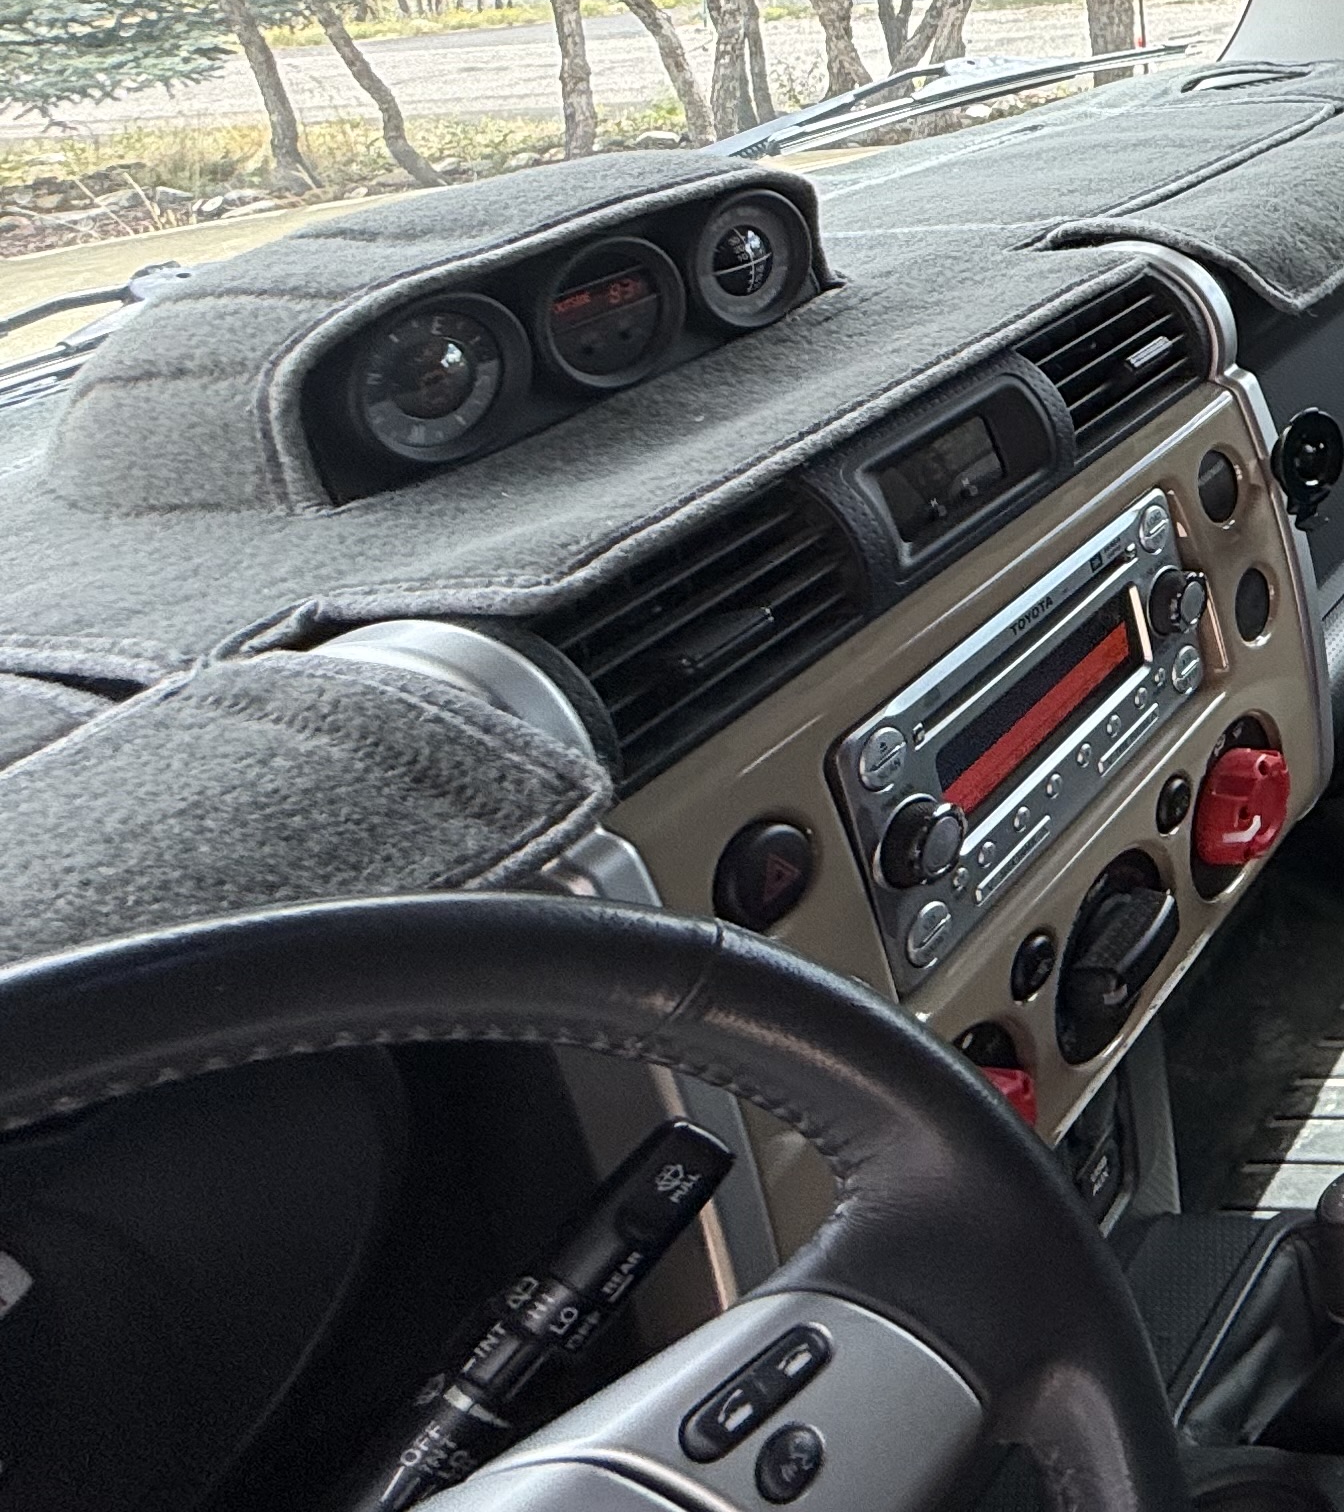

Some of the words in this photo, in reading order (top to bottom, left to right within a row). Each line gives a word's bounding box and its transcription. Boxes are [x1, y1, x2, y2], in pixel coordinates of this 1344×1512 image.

[1009, 595, 1054, 636] TOYOTA
[474, 1320, 507, 1359] INT
[549, 1306, 579, 1335] LO
[400, 1418, 442, 1467] OFF
